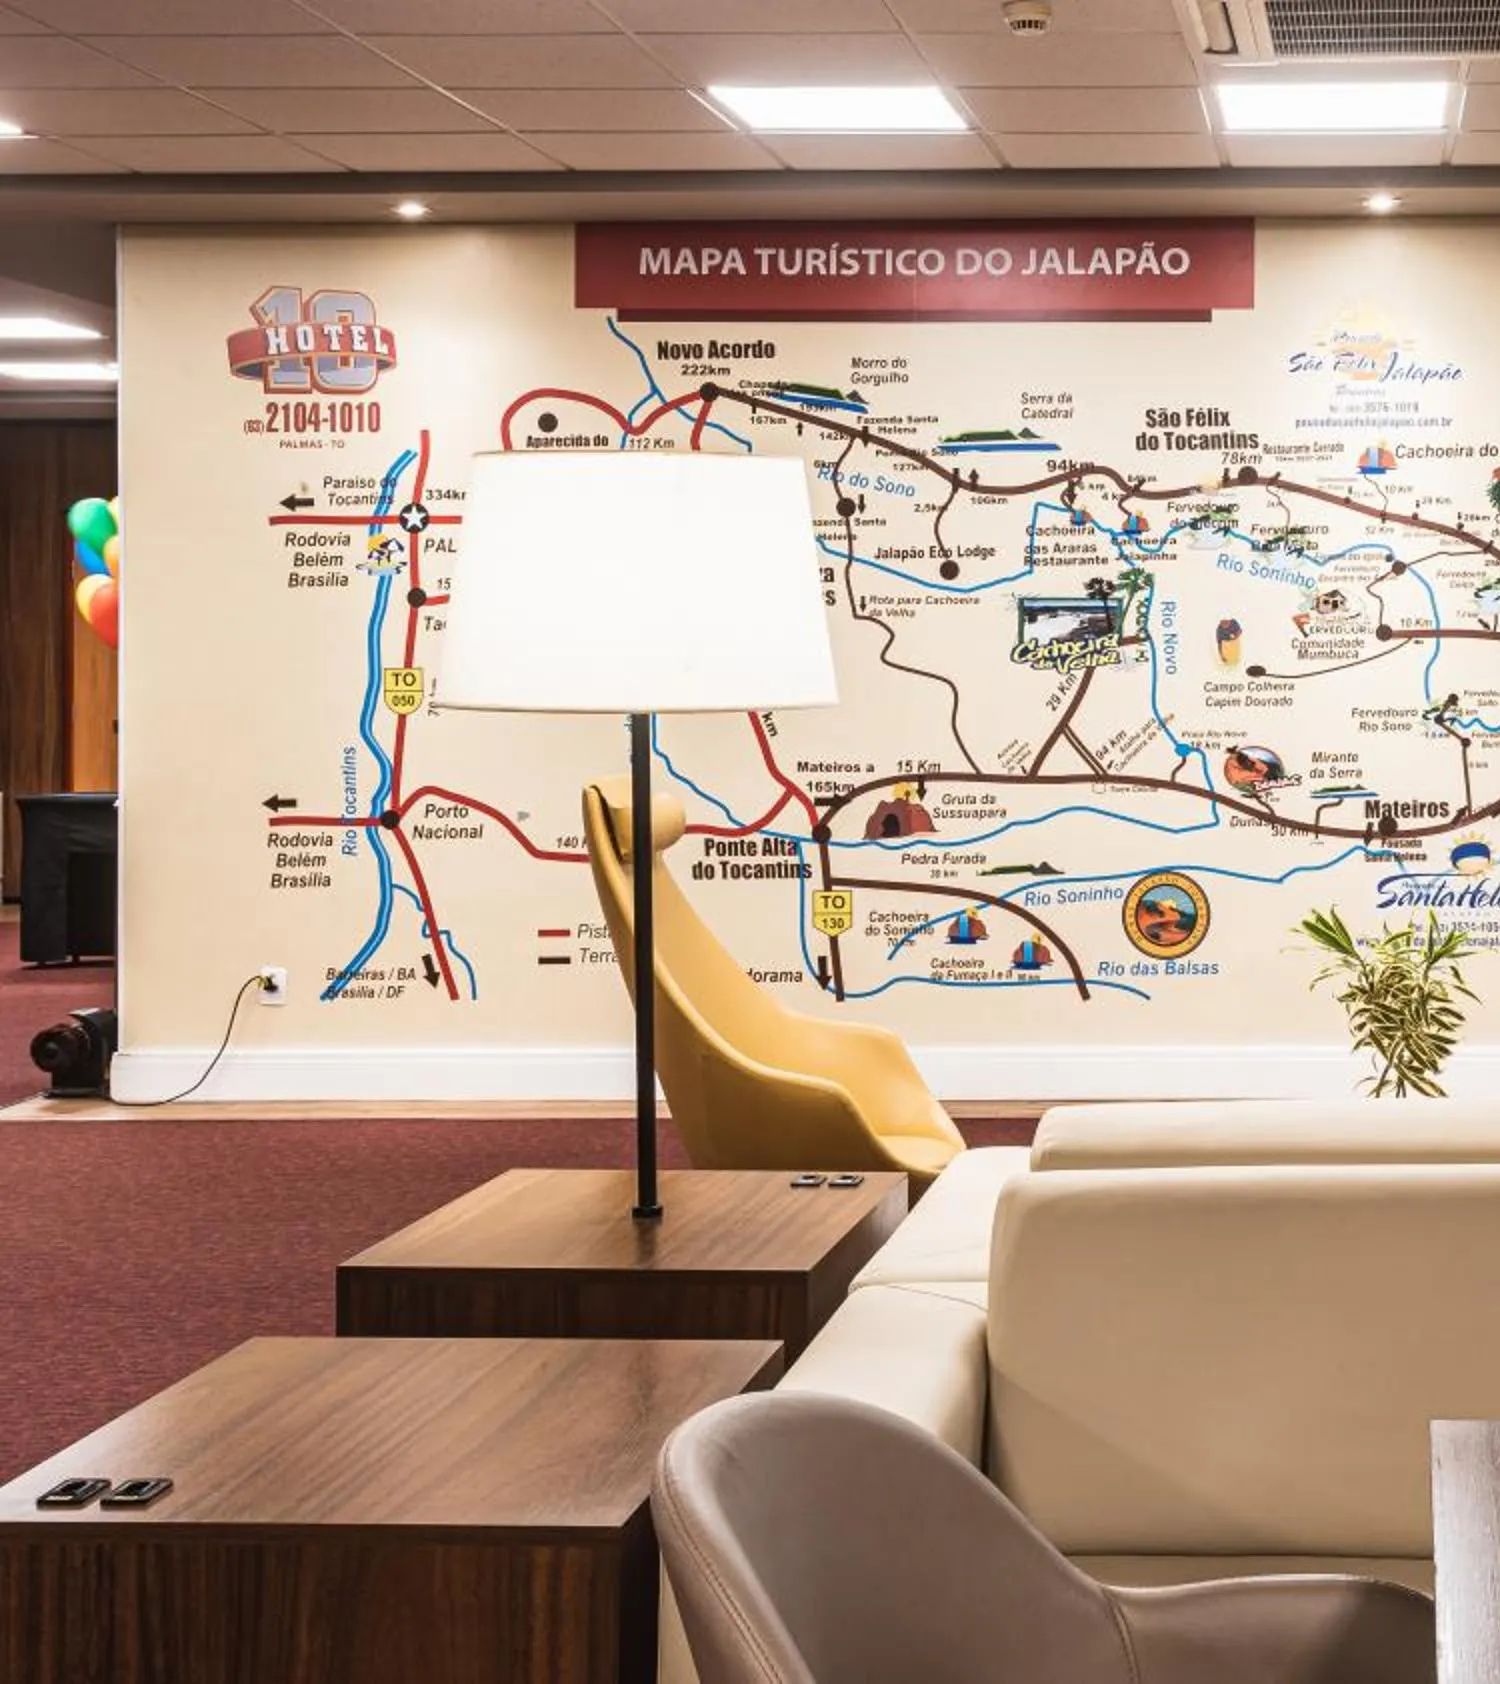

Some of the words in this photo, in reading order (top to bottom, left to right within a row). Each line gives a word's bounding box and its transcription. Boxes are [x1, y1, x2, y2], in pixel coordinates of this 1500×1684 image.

[638, 247, 747, 276] MAPA
[753, 242, 946, 276] TURÍSTICO
[956, 247, 1013, 276] DO
[1019, 241, 1190, 276] JALAPÃO
[265, 324, 389, 355] HOTEL
[657, 340, 703, 360] Novo
[708, 339, 776, 360] Acordo
[681, 365, 731, 376] 222km
[851, 357, 888, 369] Morro
[891, 356, 908, 369] do
[1021, 392, 1054, 404] Serra
[1057, 391, 1073, 404] da
[265, 402, 381, 433] 2104-1010
[1021, 407, 1074, 420] Catedral
[1145, 407, 1181, 428] São
[1185, 407, 1231, 428] Félix
[280, 440, 322, 449] PALMAS
[593, 434, 609, 448] do
[1135, 432, 1158, 451] do
[1163, 432, 1260, 451] Tocantins
[1395, 444, 1474, 459] Cachoeira
[1479, 443, 1499, 457] do
[817, 465, 845, 483] Rio
[848, 472, 870, 489] do
[873, 474, 917, 498] Sono
[284, 531, 352, 548] Rodovia
[292, 551, 344, 568] Belém
[874, 546, 927, 562] Jalapão
[957, 546, 997, 560] Lodge
[1216, 553, 1244, 573] Rio
[1250, 560, 1317, 590] Soninho
[437, 578, 452, 590] 15
[1160, 601, 1177, 629] Rio
[1163, 633, 1178, 675] Novo
[391, 672, 417, 687] TO
[1203, 681, 1245, 696] Campo
[1244, 695, 1293, 707] Dourado
[1351, 707, 1419, 719] Fervedouro
[1312, 751, 1359, 763] Mirante
[797, 761, 862, 773] Mateiros
[864, 763, 875, 773] a
[896, 760, 913, 773] 15
[917, 760, 941, 774] Km
[1309, 767, 1326, 779] da
[1329, 766, 1363, 779] Serra
[941, 793, 978, 806] Gruta
[980, 794, 997, 805] da
[424, 803, 469, 819] Porto
[932, 807, 1008, 822] Sussuapara
[1364, 799, 1450, 820] Mateiros
[267, 832, 334, 848] Rodovia
[411, 824, 484, 840] Nacional
[341, 829, 358, 857] Rio
[556, 837, 579, 849] 140
[703, 838, 757, 857] Ponte
[761, 837, 799, 857] Alta
[275, 852, 327, 868] Belém
[901, 853, 939, 865] Pedra
[691, 861, 716, 880] do
[719, 861, 813, 880] Tocantins
[1024, 890, 1052, 907] Rio
[1056, 886, 1125, 905] Soninho
[1376, 873, 1457, 910] Santa
[820, 895, 845, 909] TO
[821, 916, 845, 930] 130
[869, 911, 930, 923] Cachoeira
[396, 967, 417, 981] BA
[1097, 960, 1126, 977] Rio
[1129, 960, 1159, 976] das
[1163, 960, 1220, 976] Balsas
[385, 985, 406, 998] DF
